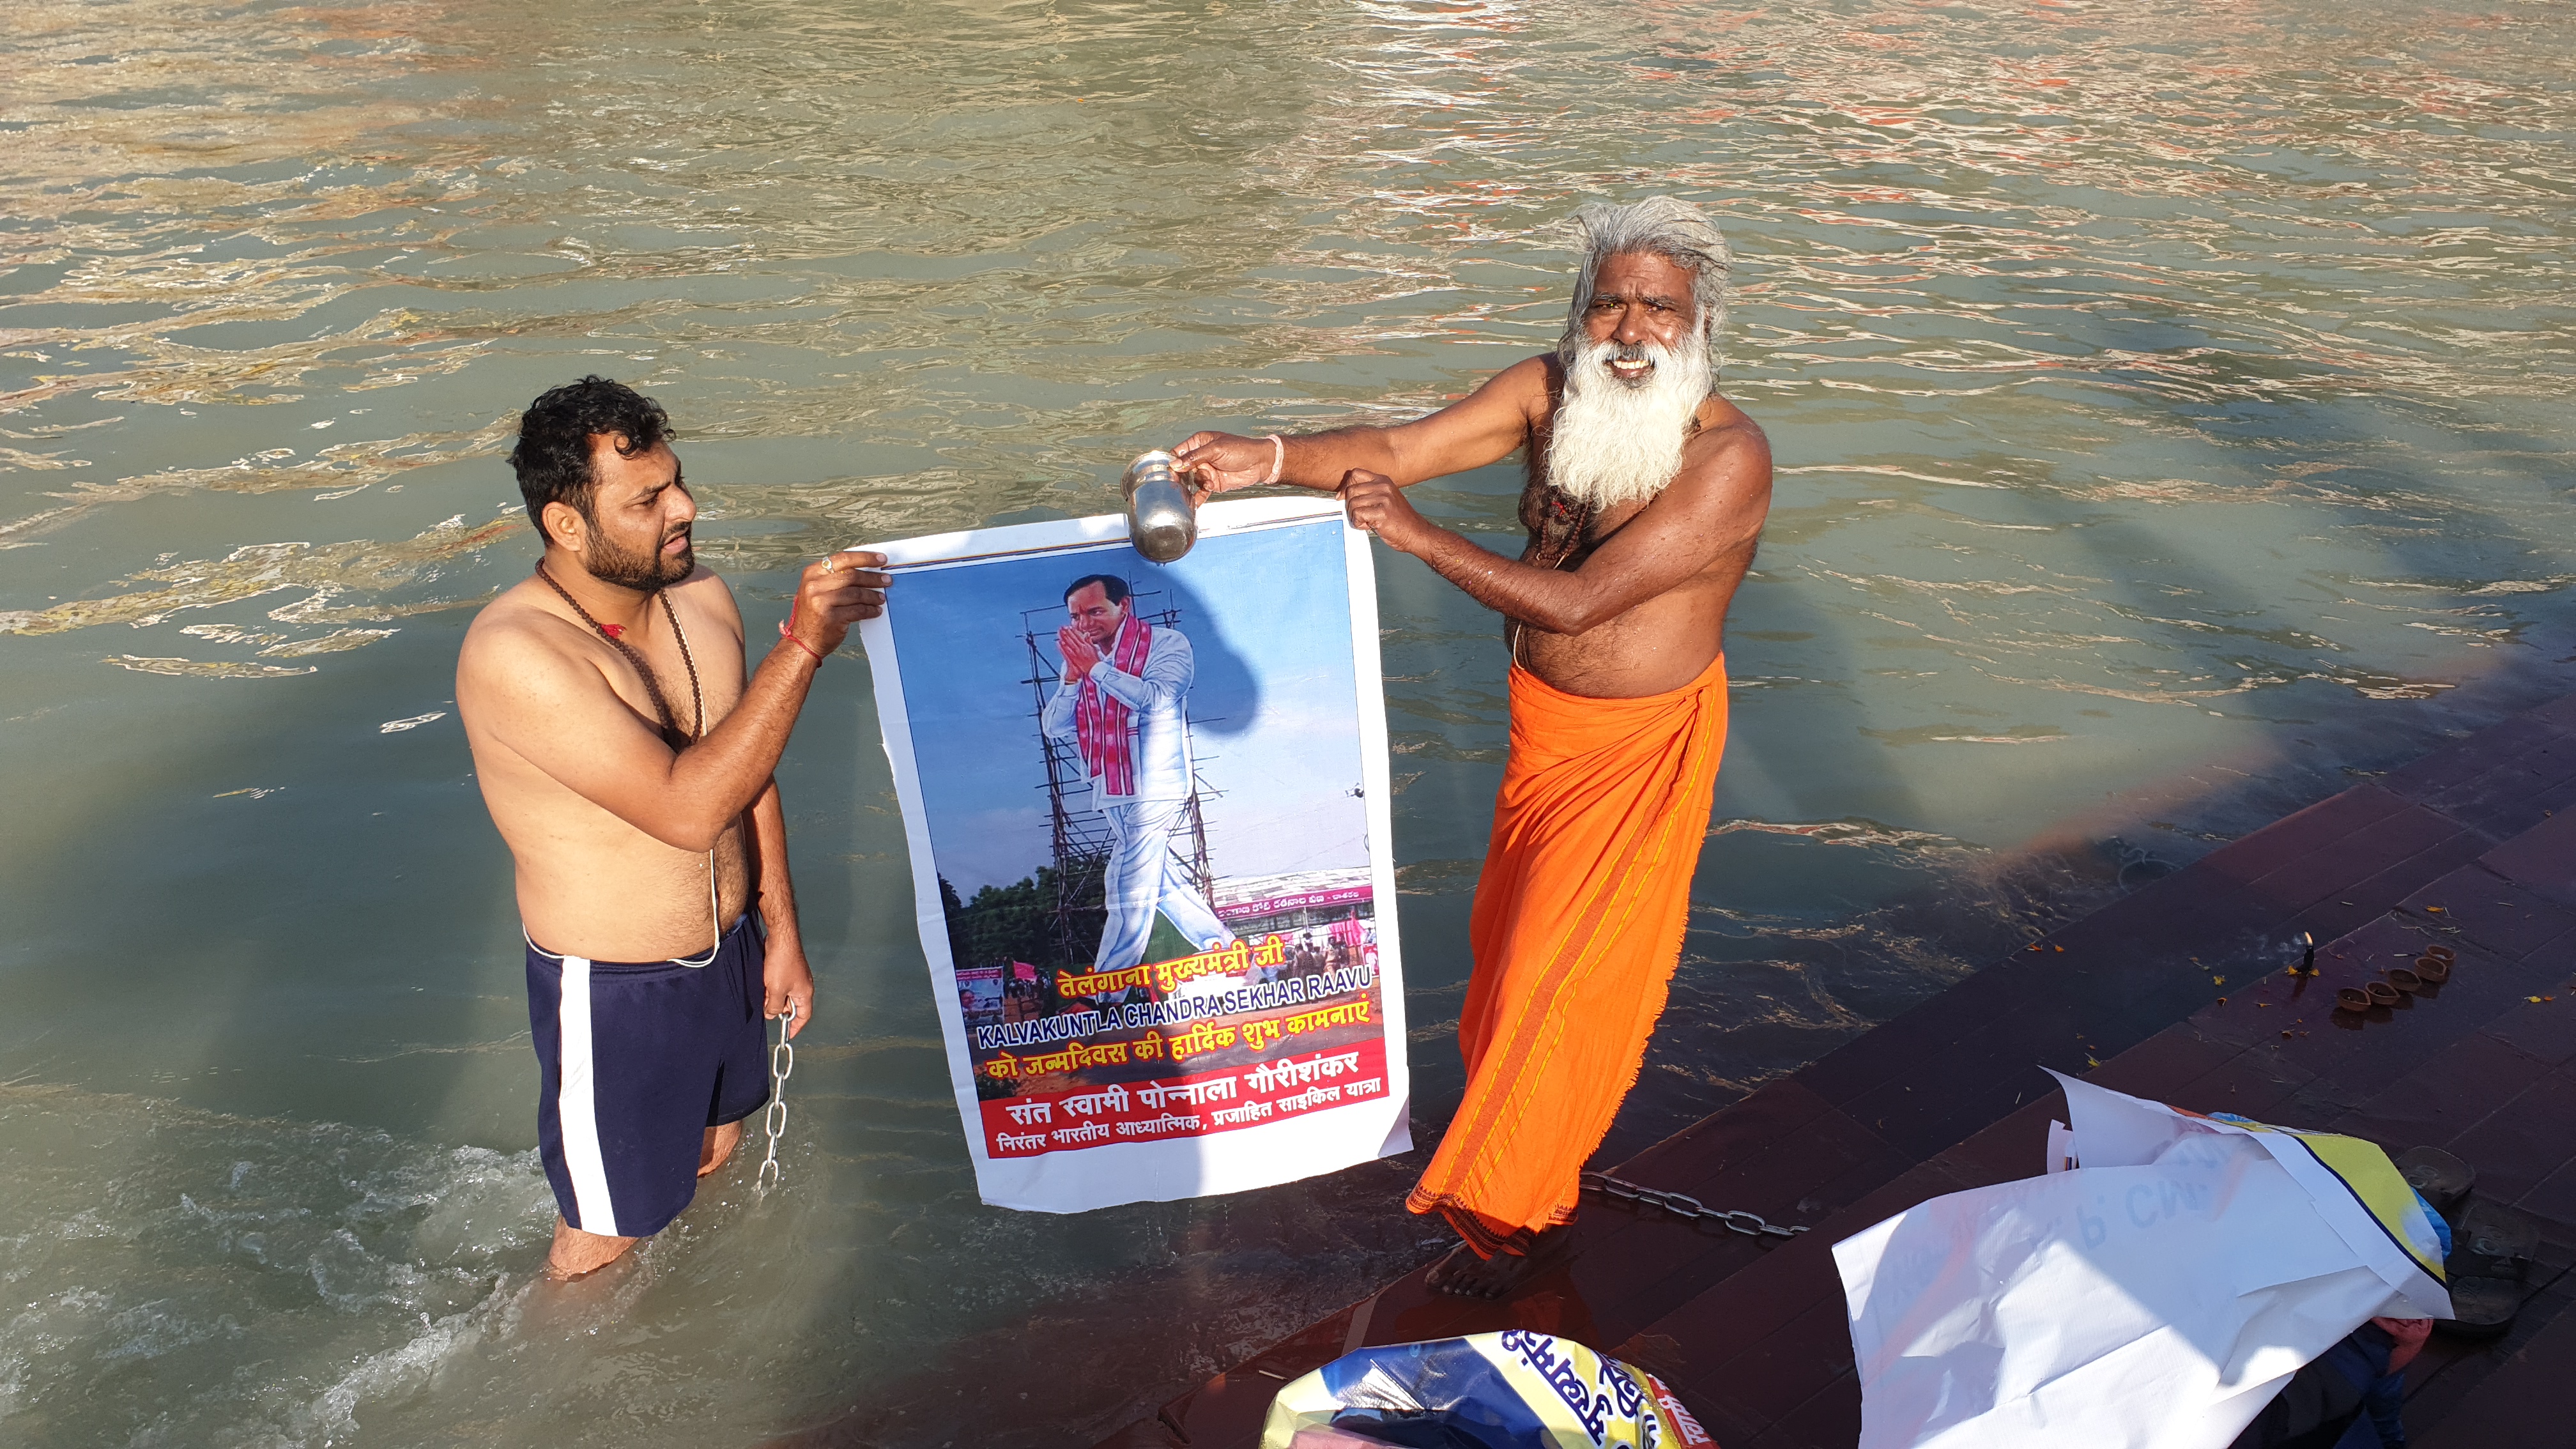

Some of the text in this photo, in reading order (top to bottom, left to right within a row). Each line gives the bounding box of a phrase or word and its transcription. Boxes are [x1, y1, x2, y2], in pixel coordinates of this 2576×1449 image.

[1057, 935, 1284, 997] तेलंगाना मुख्यमंत्री जी
[977, 965, 1372, 1049] KALVAKUNTLA CHANDRA SEKHAR RAAVU
[987, 992, 1370, 1077] को जन्मदिवस की हार्दिक शुभ कामनाएं
[996, 1131, 1046, 1152] निरंतर
[1051, 1120, 1110, 1144] भारतीय
[1211, 1101, 1273, 1126] प्रजाहित
[1276, 1085, 1341, 1112] साइकिल
[1344, 1077, 1381, 1097] यात्रा
[1006, 1051, 1360, 1125] संत स्वामी पोन्नाला गौरीशंकर
